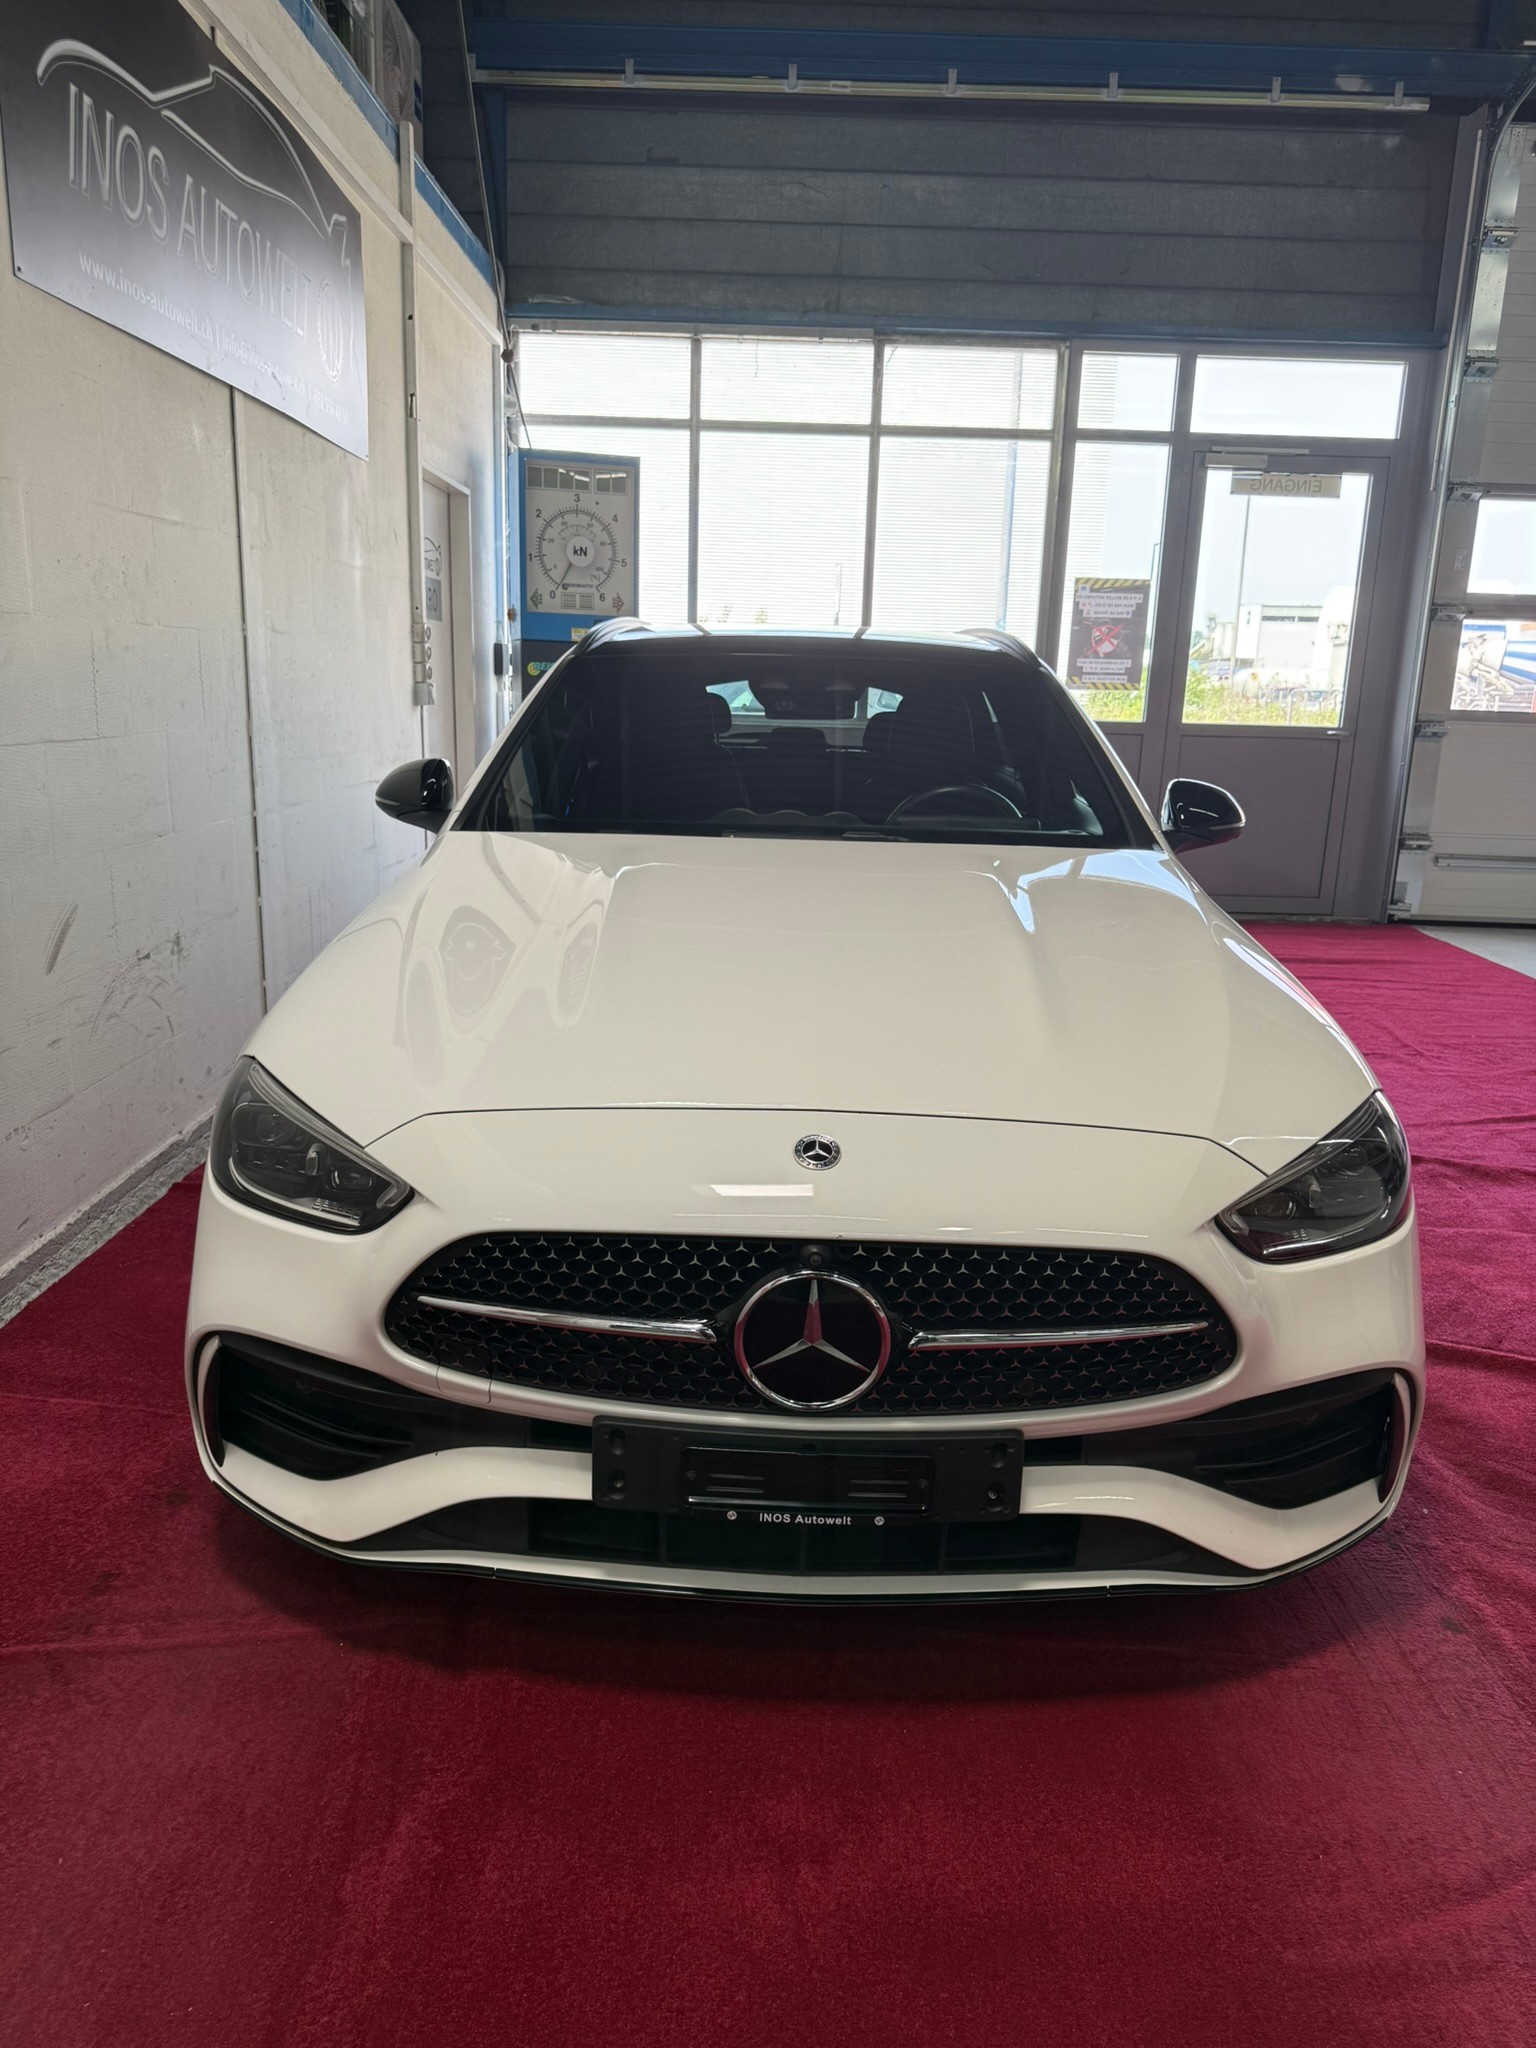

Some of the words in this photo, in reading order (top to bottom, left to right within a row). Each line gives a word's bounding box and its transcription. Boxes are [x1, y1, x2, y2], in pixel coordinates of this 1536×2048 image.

[69, 83, 169, 245] INOS
[177, 173, 312, 343] AUTOWELT
[79, 251, 213, 343] www.inos-autowelt.ch
[574, 494, 580, 503] 3
[535, 509, 542, 518] 2
[612, 514, 618, 523] 4
[573, 545, 588, 557] kN
[528, 553, 532, 562] 1
[620, 559, 627, 567] 5
[549, 590, 556, 599] 0
[600, 593, 606, 602] 6
[759, 1512, 791, 1523] INOS
[795, 1514, 852, 1525] Autowelt
